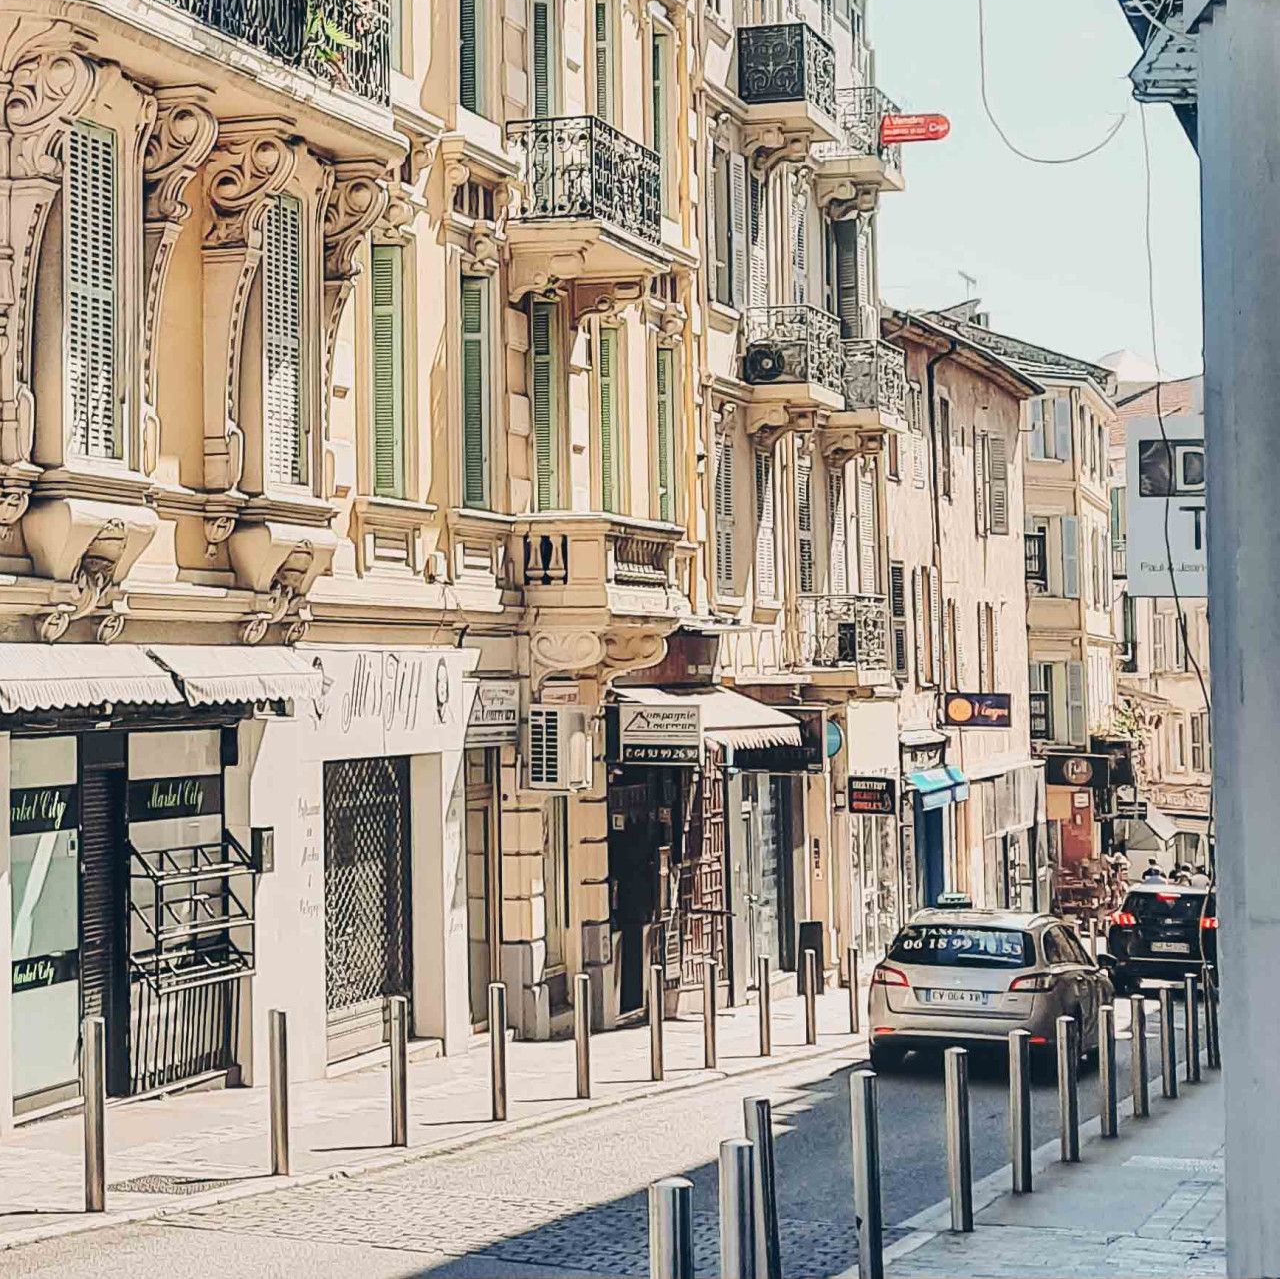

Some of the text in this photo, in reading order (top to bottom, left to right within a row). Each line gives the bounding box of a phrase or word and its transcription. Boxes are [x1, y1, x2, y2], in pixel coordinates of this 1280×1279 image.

[644, 711, 696, 721] ompagnie
[39, 791, 66, 829] City
[148, 780, 204, 814] Market City
